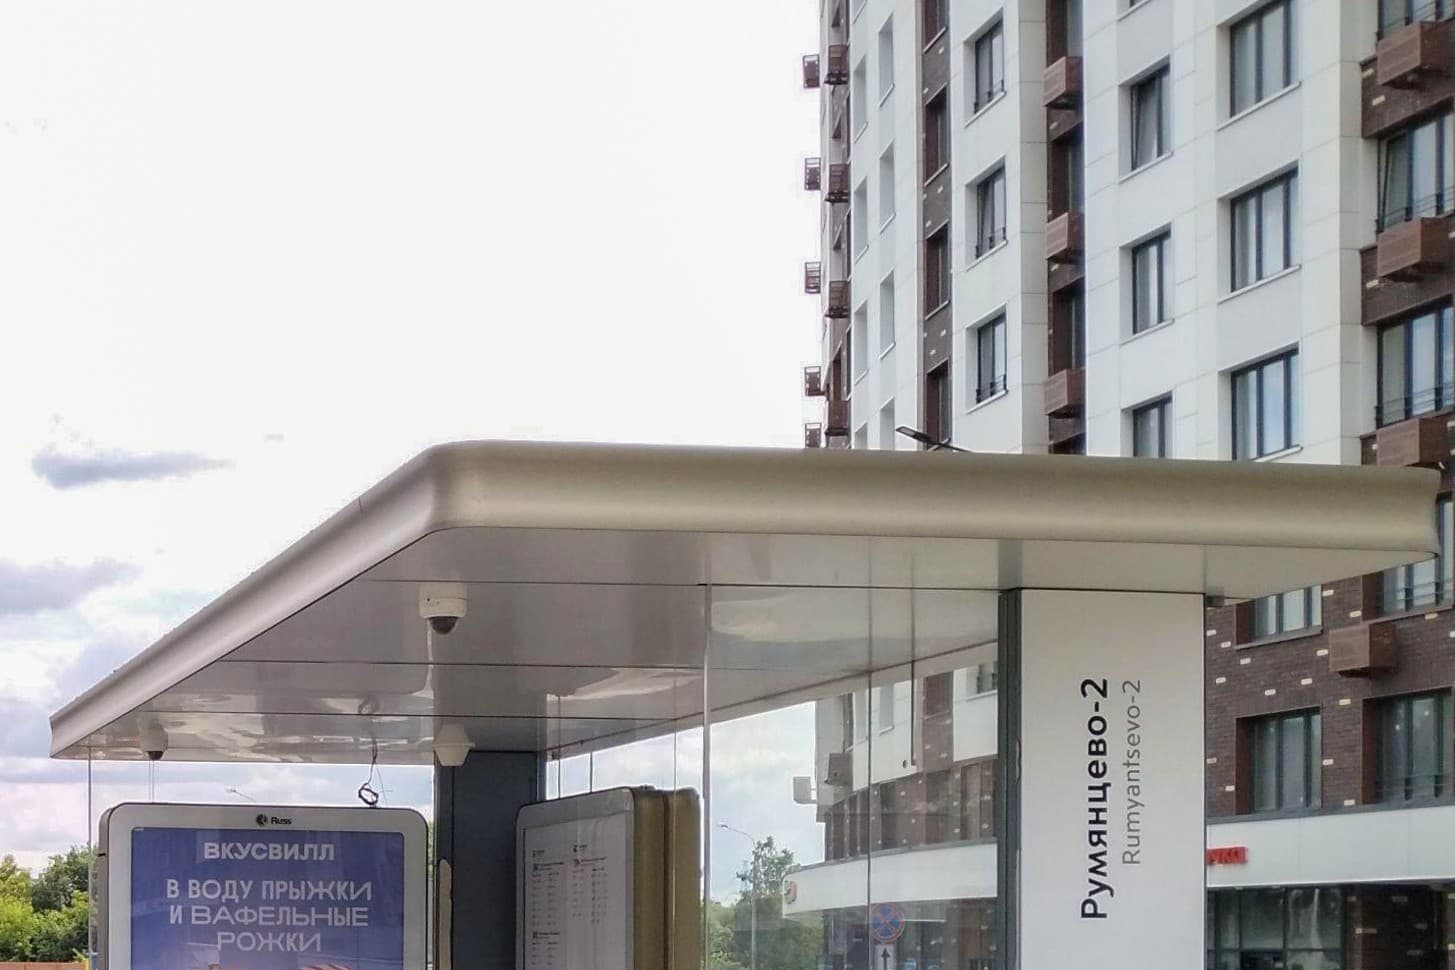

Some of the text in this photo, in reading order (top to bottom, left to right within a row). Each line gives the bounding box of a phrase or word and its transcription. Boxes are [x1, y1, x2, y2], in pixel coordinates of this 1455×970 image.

[1122, 680, 1145, 864] Rumyantsevo-2
[1081, 679, 1114, 918] Румянцево-2
[204, 842, 335, 861] ВКУСВИЛЛ
[167, 879, 372, 903] В ВОДУ ПРЫЖКИ
[170, 905, 369, 926] И ВАФЕЛЬНЫЕ
[217, 932, 322, 952] РОЖКИ
